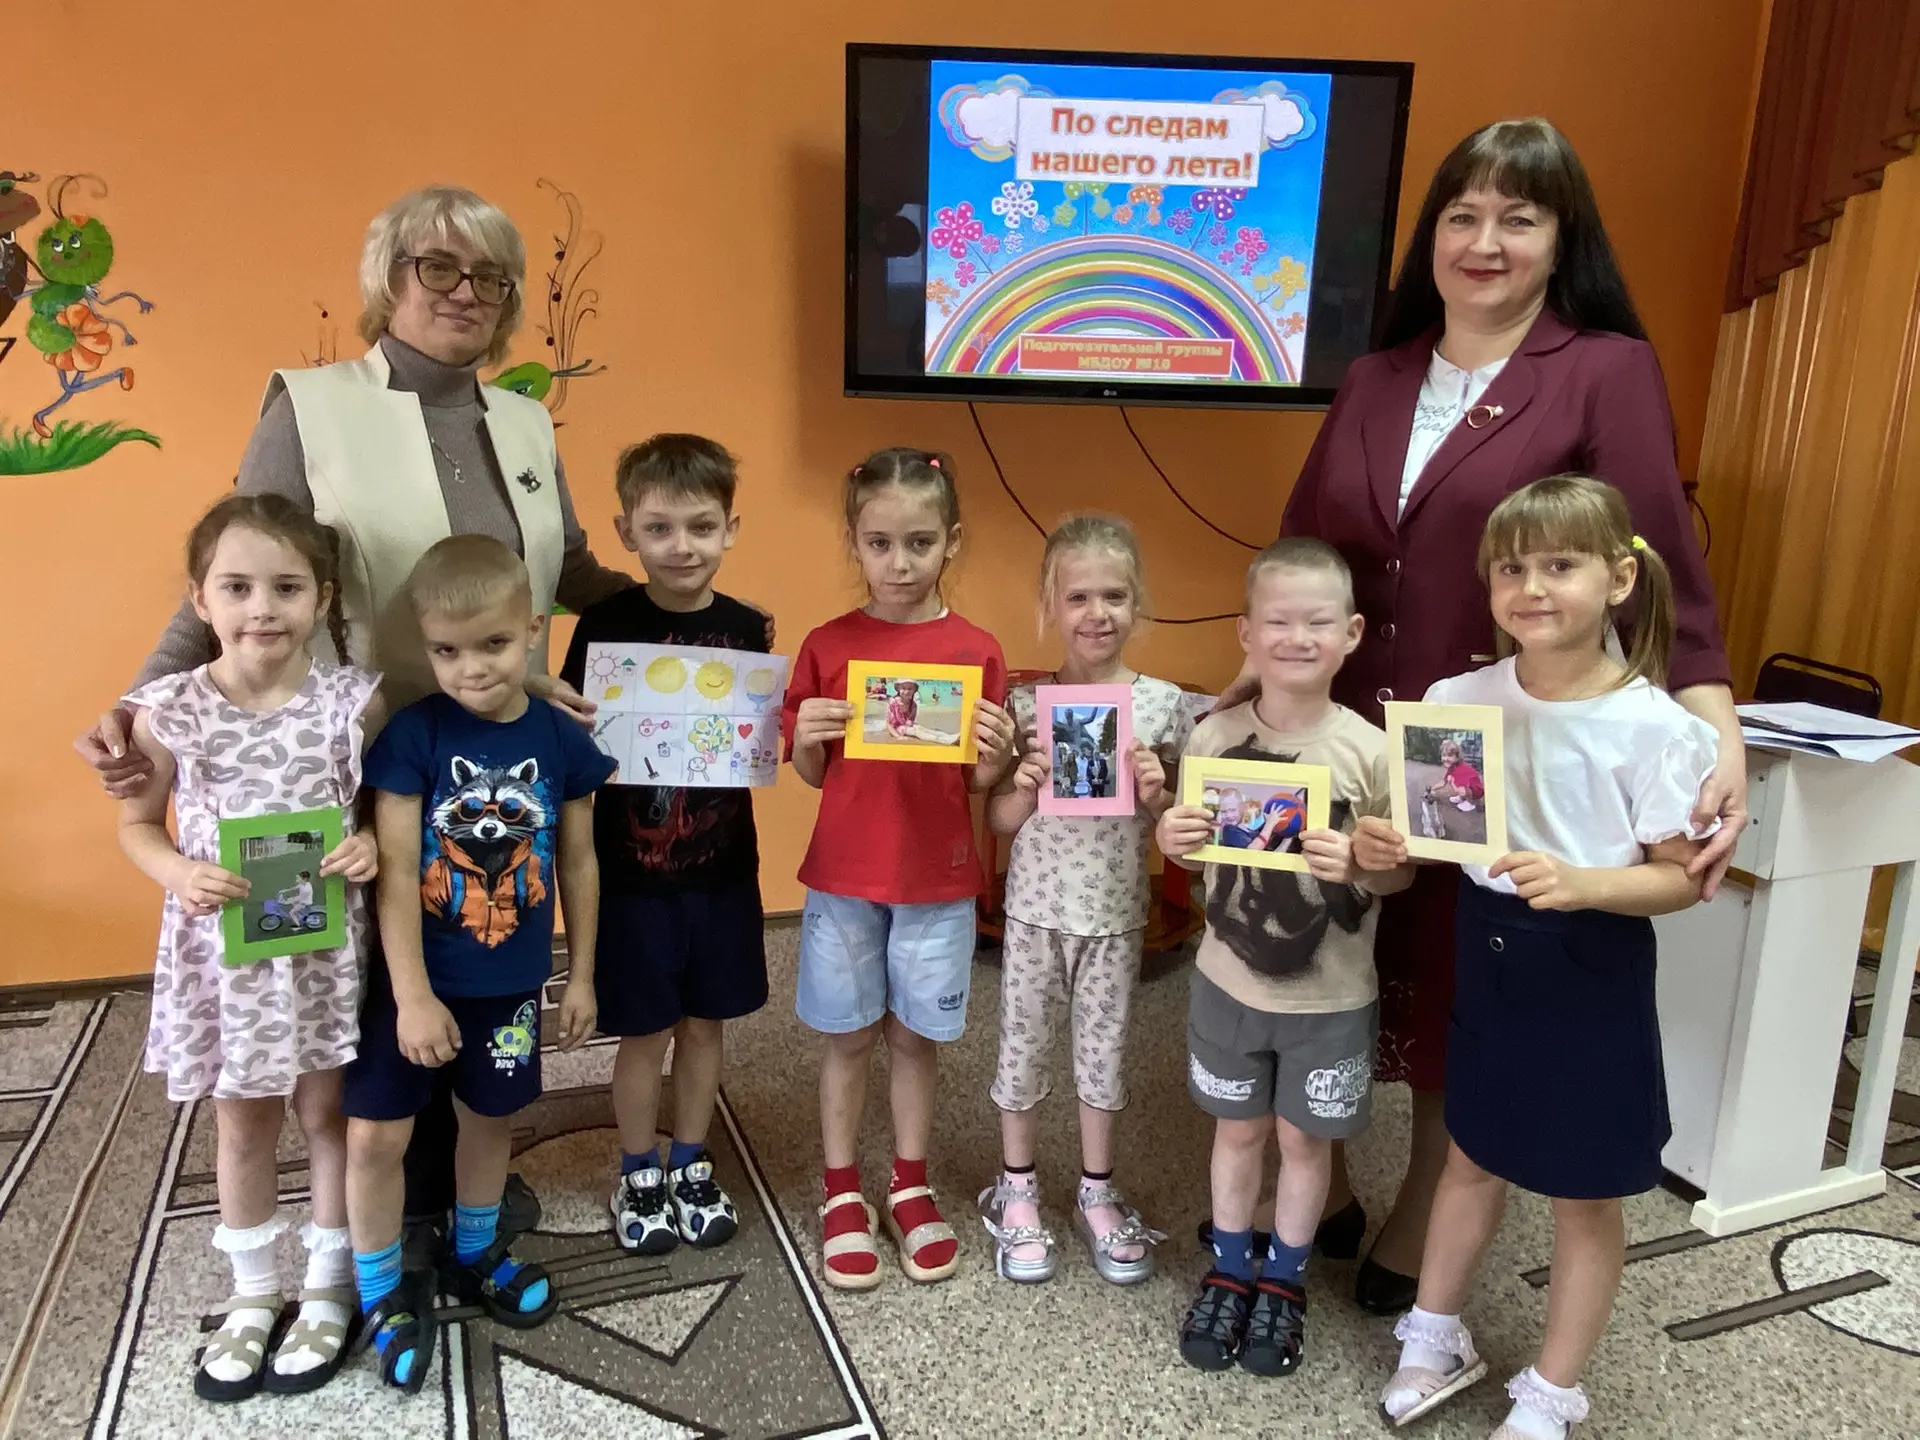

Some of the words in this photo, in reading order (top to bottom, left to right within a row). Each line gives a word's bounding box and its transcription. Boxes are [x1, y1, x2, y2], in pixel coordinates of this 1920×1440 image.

[1051, 107, 1096, 134] По
[1106, 114, 1229, 141] следам
[1031, 151, 1156, 175] нашего
[1165, 152, 1253, 178] лета!
[1024, 339, 1163, 354] Подготовительной
[1167, 345, 1223, 357] группы
[1078, 356, 1132, 370] МБДОУ
